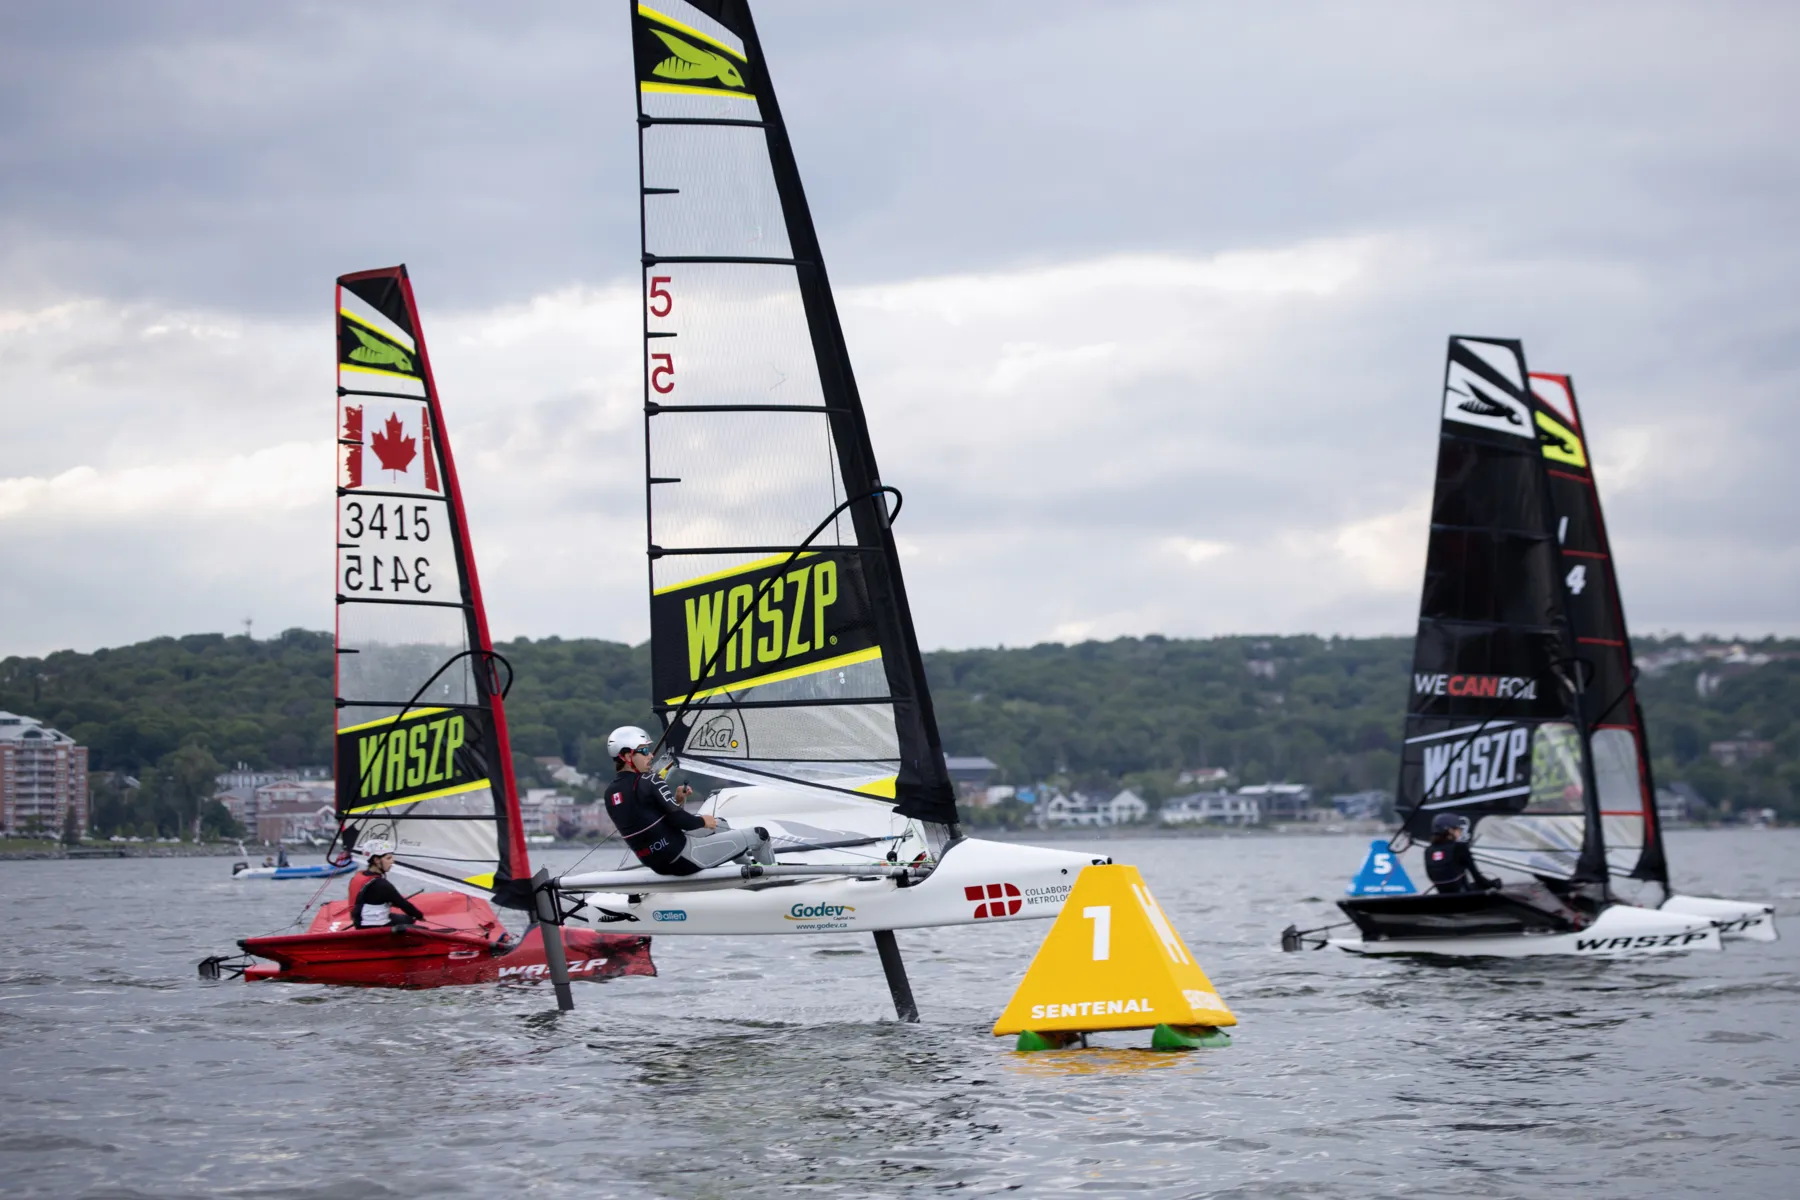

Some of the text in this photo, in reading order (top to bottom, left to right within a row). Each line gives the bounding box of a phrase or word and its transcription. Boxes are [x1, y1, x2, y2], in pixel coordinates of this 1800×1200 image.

[649, 276, 673, 318] 5
[344, 501, 431, 542] 3415
[1565, 564, 1587, 595] 4
[684, 559, 838, 682] WASZP
[358, 714, 465, 798] WASZP
[1423, 727, 1529, 799] WASZP
[1372, 852, 1393, 875] 5
[662, 911, 687, 921] allen
[790, 901, 845, 918] Godev
[796, 921, 848, 931] www.godev.ca
[1082, 905, 1112, 961] 1
[1575, 932, 1709, 951] WASZP
[498, 958, 609, 978] WAZP
[1030, 998, 1155, 1020] SENTENAL
